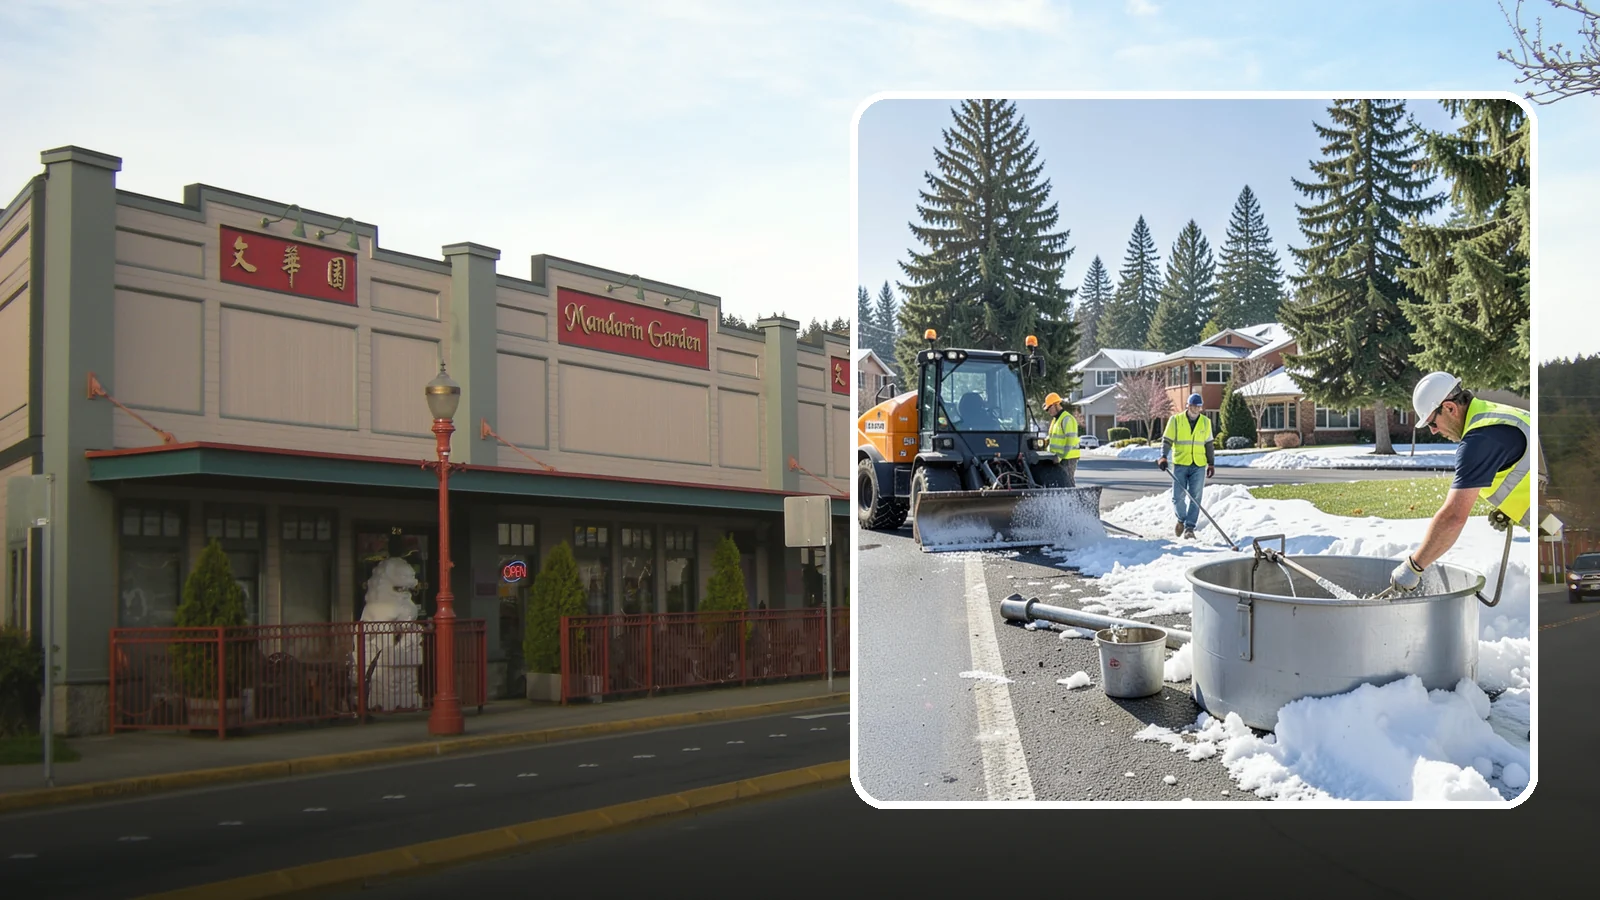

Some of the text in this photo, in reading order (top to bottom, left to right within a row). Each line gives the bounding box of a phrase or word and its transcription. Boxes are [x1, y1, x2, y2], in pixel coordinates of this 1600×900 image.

[230, 235, 346, 290] 文華園
[564, 302, 701, 352] Mandarin Garden
[503, 565, 527, 578] OPEN
